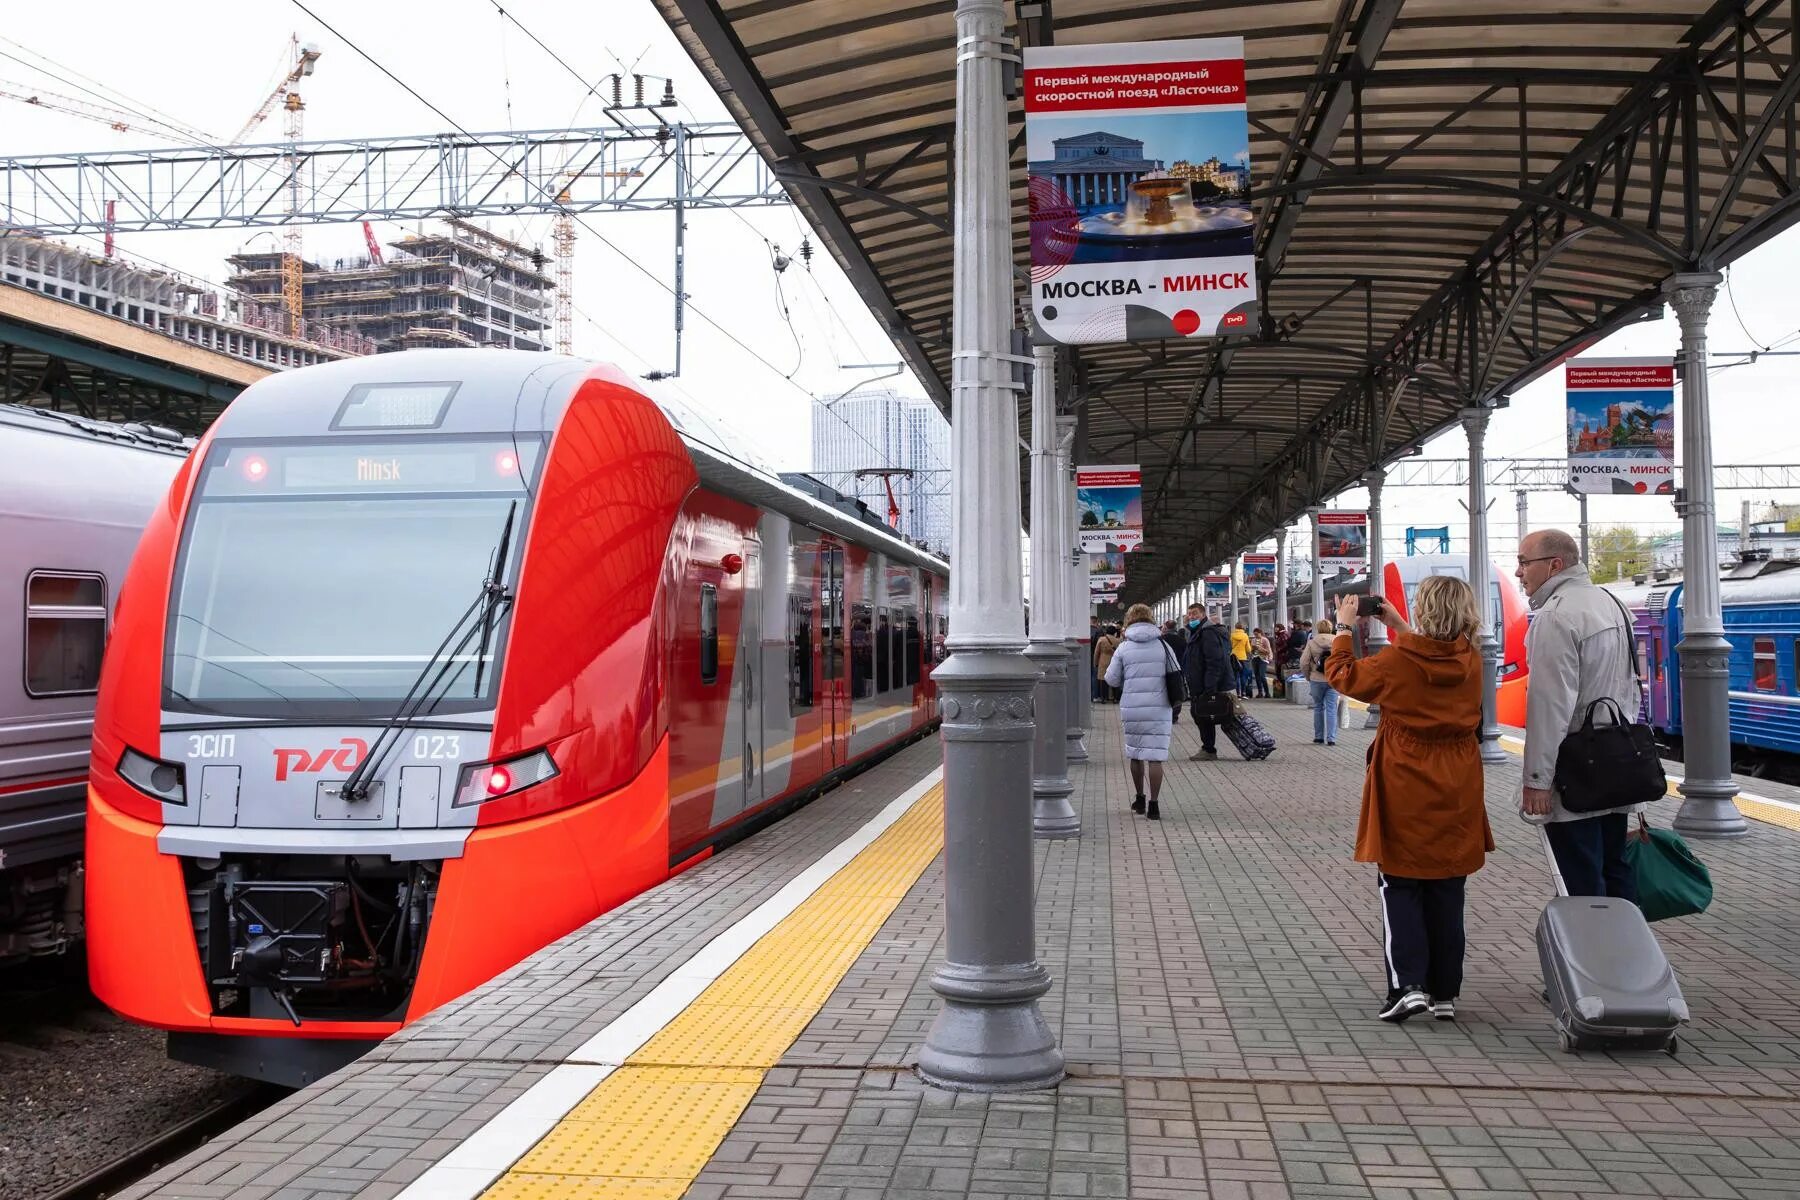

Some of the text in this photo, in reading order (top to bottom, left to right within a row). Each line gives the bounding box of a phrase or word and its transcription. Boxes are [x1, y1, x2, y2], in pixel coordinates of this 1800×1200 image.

[1034, 68, 1209, 87] Первый международный
[1035, 84, 1239, 103] скоростной поезд «Ласточка»
[1041, 278, 1143, 299] МОСКВА
[1163, 272, 1250, 293] МИНСК
[357, 458, 401, 481] Minsk
[1571, 465, 1620, 474] МОСКВА
[1629, 465, 1671, 474] МИНСК
[413, 735, 461, 759] 023
